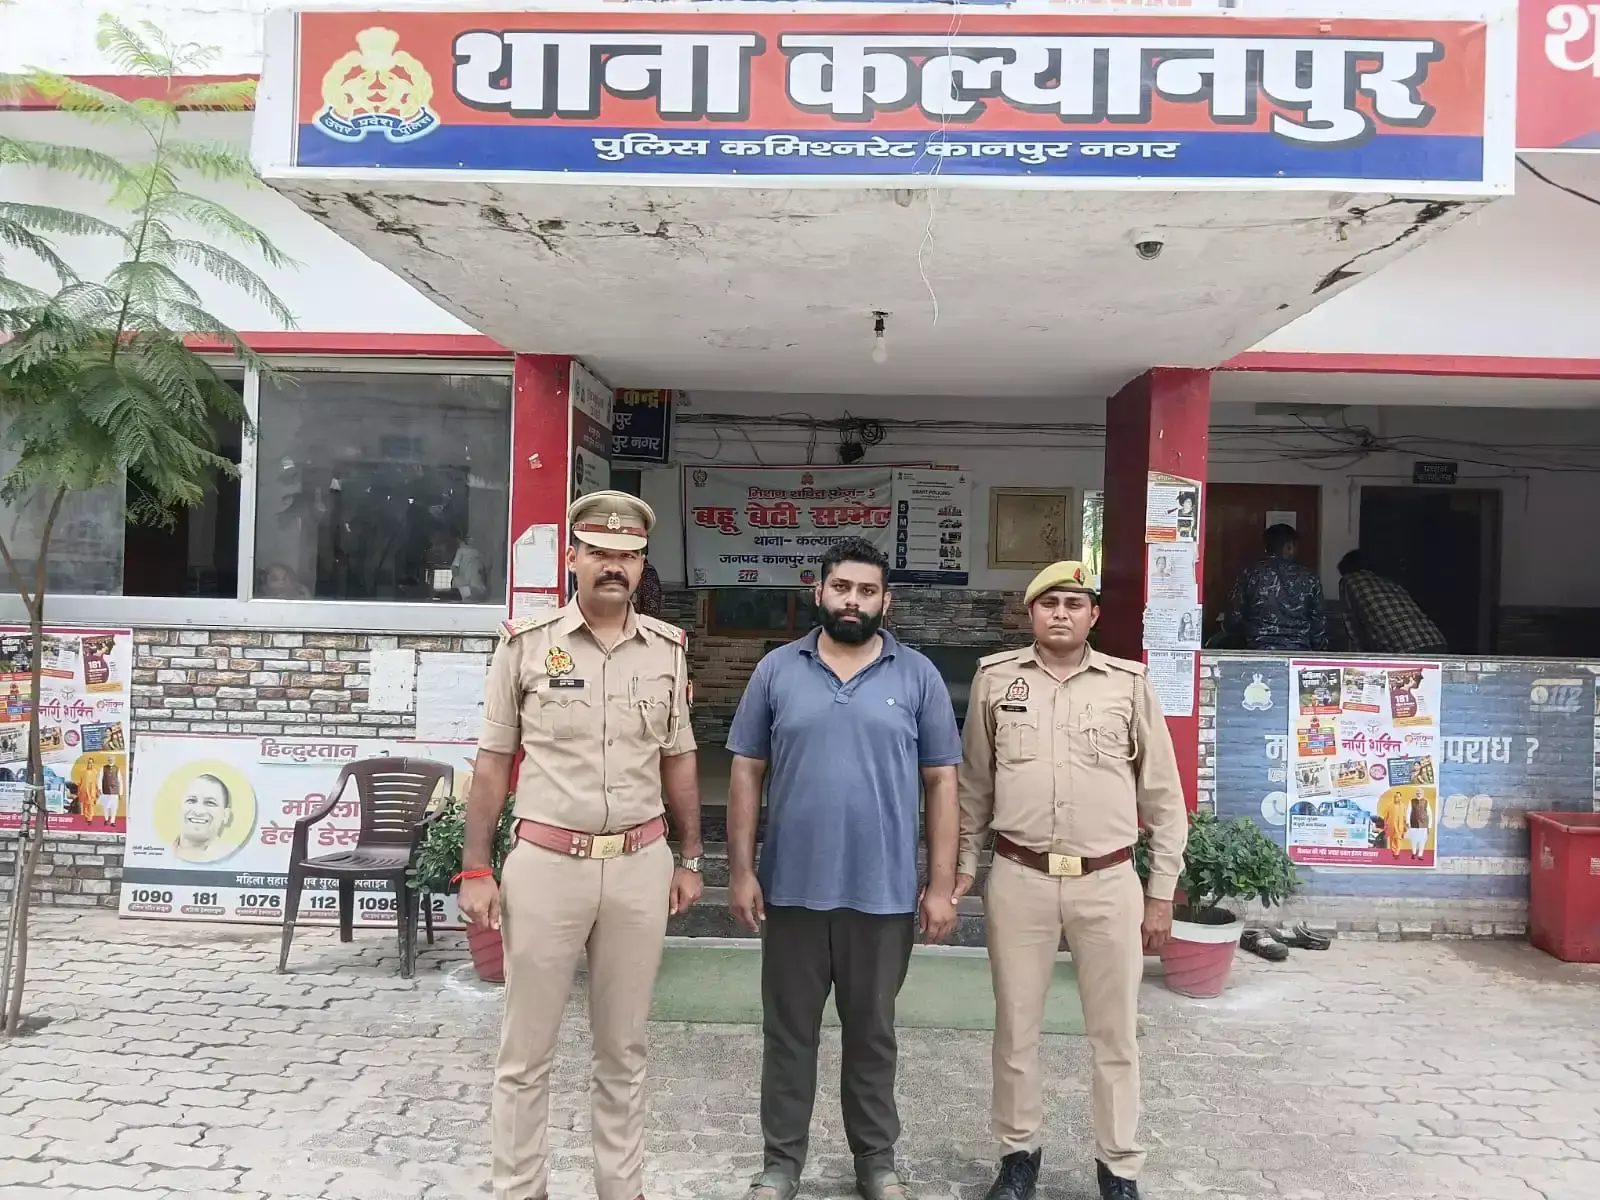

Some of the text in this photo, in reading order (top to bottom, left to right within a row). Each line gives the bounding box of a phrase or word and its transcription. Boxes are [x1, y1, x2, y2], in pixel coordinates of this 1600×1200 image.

[454, 30, 1435, 142] थाना कल्यानपुर
[592, 132, 1182, 163] पुलिस कमिश्नरेट कानपुर नगर
[631, 437, 661, 450] नगर
[692, 501, 891, 535] बहू बेटी सम्मेल
[796, 535, 860, 546] कल्यान
[719, 554, 759, 564] जनपद
[763, 554, 804, 568] कानपुर
[260, 738, 358, 762] हिन्दुस्तान
[1526, 738, 1540, 765] ?
[318, 822, 361, 846] डेस्
[236, 873, 265, 886] महिला
[319, 878, 340, 890] सुरक्ष
[131, 889, 173, 903] 1090
[192, 892, 218, 905] 181
[239, 894, 281, 908] 1076
[310, 896, 337, 909] 112
[358, 897, 397, 910] 1098
